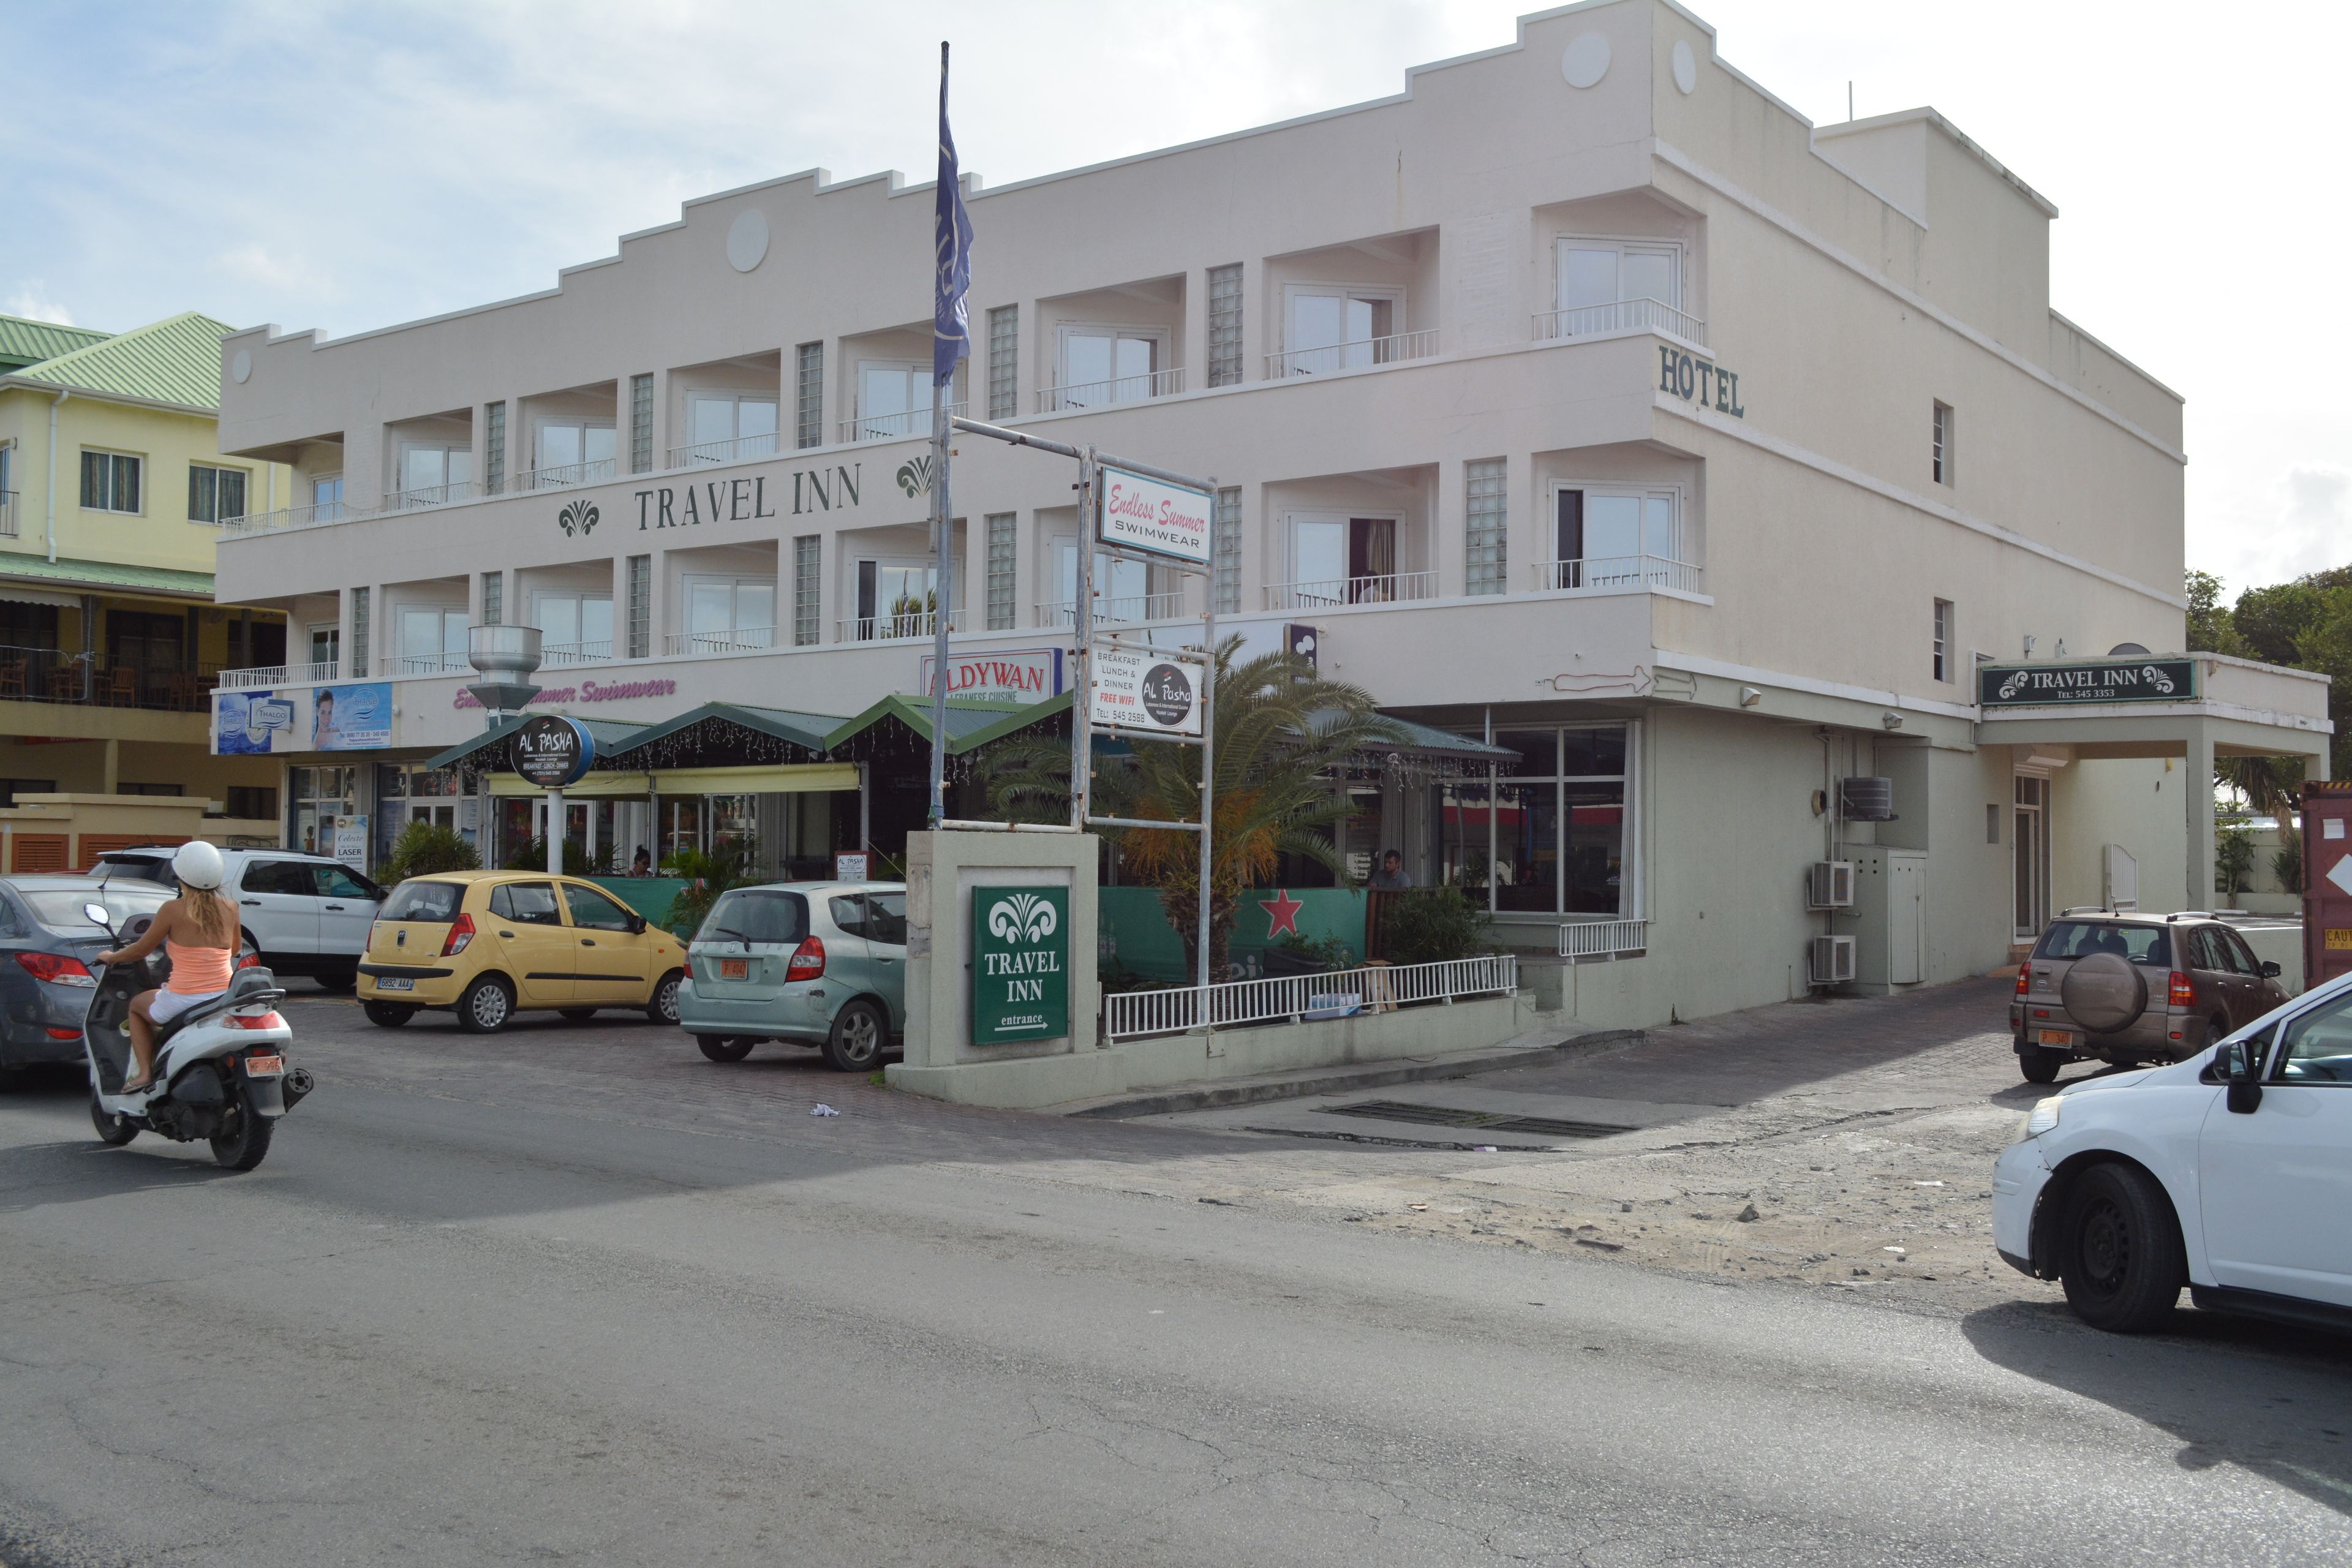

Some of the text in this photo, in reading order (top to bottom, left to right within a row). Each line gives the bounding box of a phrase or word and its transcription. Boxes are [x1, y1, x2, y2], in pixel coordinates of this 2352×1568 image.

[1659, 345, 1744, 419] HOTEL
[635, 463, 861, 531] TRAVEL INN
[1109, 484, 1205, 533] Endless Summer
[1115, 520, 1199, 548] SWIMWEAR
[1098, 652, 1140, 666] BREAKFAST
[1101, 665, 1128, 677] LUNCH
[2032, 669, 2138, 688] TRAVEL INN
[579, 678, 676, 703] Swimwear
[1104, 679, 1133, 690] DINNER
[988, 691, 1017, 703] CUISINE
[1099, 692, 1135, 706] FREE WIFI
[1161, 684, 1191, 702] Pasha
[2094, 689, 2115, 698] 3353
[1113, 710, 1126, 720] 545
[1128, 712, 1145, 723] 2588
[519, 731, 573, 752] AL PASHA
[725, 965, 729, 974] P
[984, 951, 1060, 975] TRAVEL
[1007, 979, 1043, 1002] INN
[1001, 1014, 1042, 1025] entrance
[2056, 1033, 2069, 1044] 340
